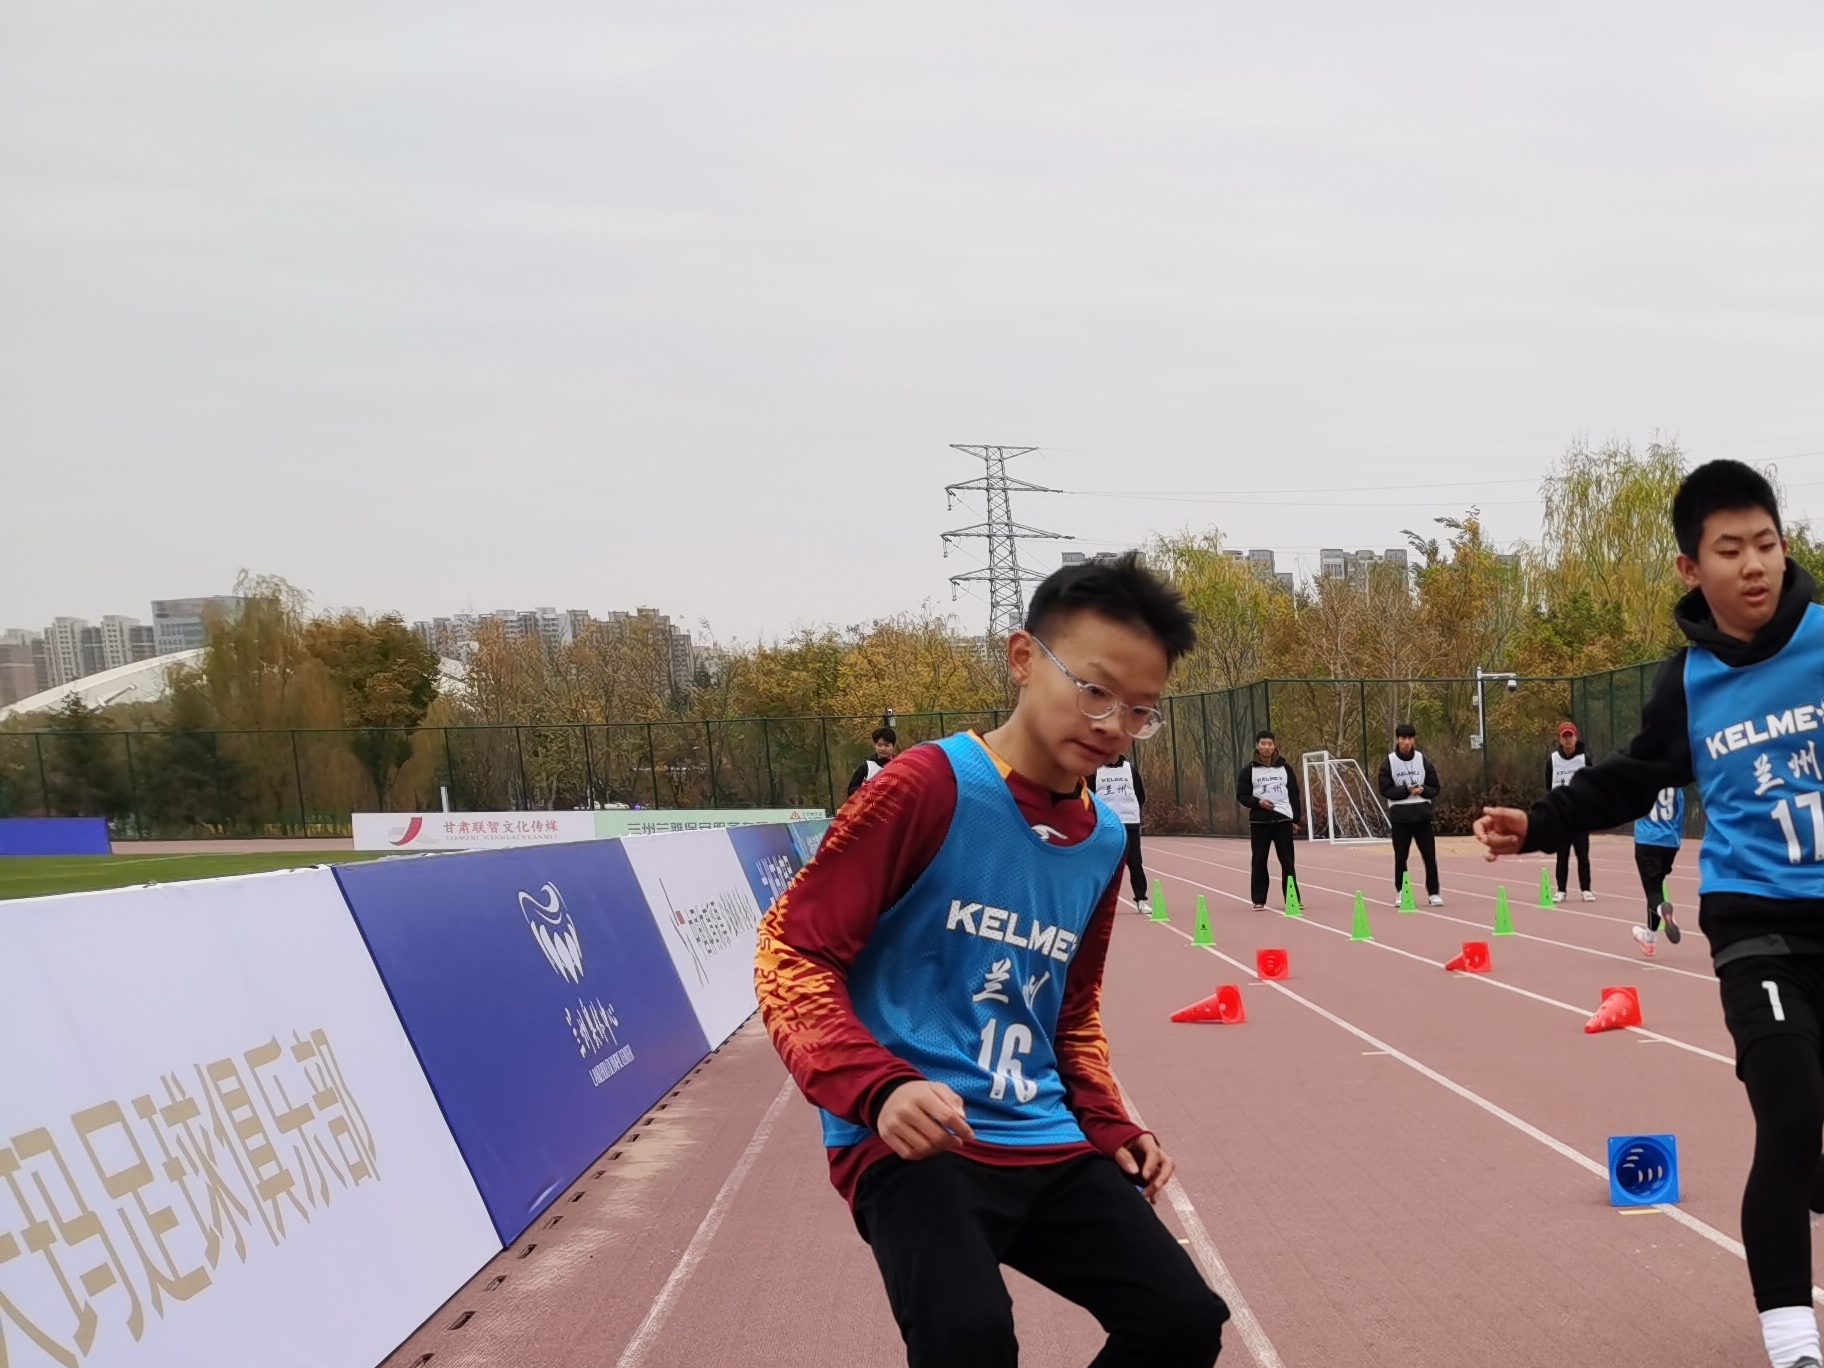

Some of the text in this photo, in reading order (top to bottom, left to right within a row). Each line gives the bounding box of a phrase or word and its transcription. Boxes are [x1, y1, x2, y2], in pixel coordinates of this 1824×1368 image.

[1706, 705, 1819, 760] KELME
[1753, 740, 1823, 796] 兰州
[443, 819, 559, 834] 甘肃联智文化传媒
[946, 900, 1077, 962] KELME
[1761, 980, 1786, 1021] 1
[978, 1018, 1039, 1104] 16
